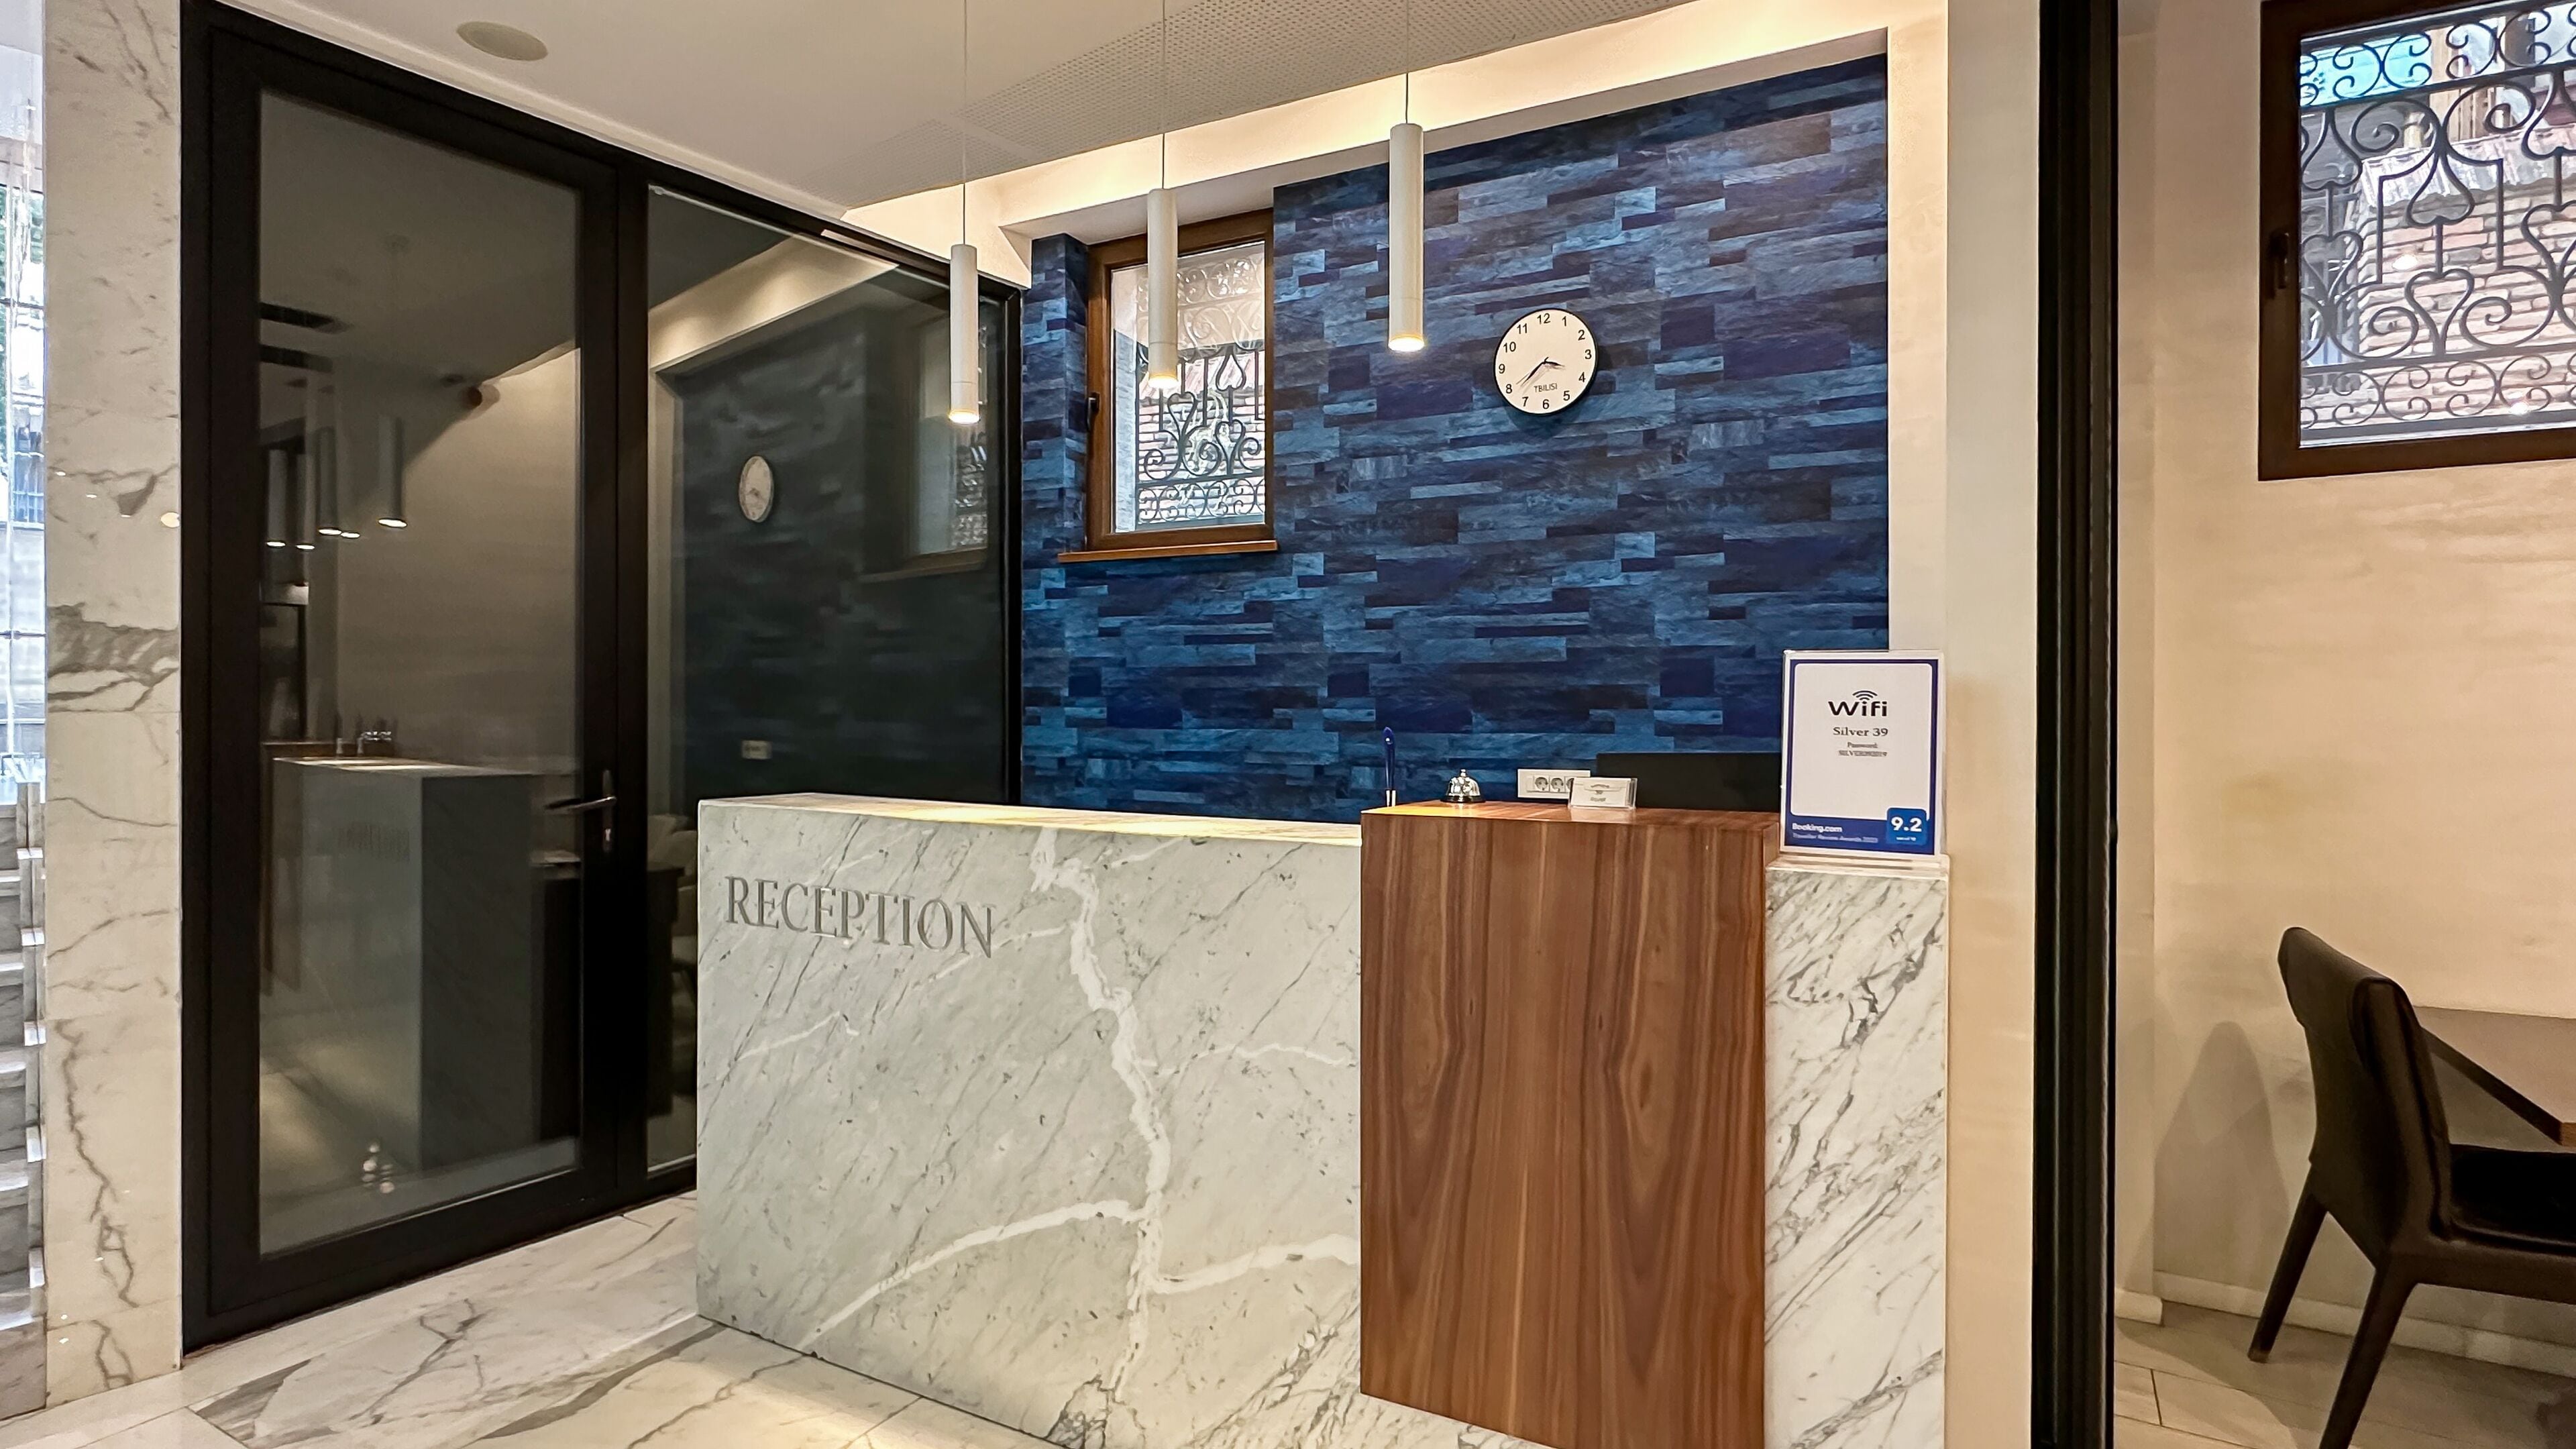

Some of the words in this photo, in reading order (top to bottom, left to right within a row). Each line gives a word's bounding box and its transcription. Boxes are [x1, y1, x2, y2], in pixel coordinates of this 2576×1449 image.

[1537, 313, 1551, 325] 12
[1562, 316, 1567, 327] 1
[1517, 323, 1528, 334] 11
[1578, 329, 1585, 341] 2
[1503, 341, 1516, 353] 10
[1585, 350, 1591, 360] 3
[1499, 364, 1505, 374] 9
[1578, 372, 1586, 382] 4
[1505, 384, 1513, 394] 8
[1534, 383, 1557, 392] TBILISI
[1563, 390, 1570, 401] 5
[1522, 396, 1529, 407] 7
[1542, 399, 1550, 409] 6
[1828, 701, 1888, 716] Wifi
[1833, 727, 1869, 737] Silver
[1872, 728, 1888, 737] 39
[1891, 816, 1922, 832] 9.2
[724, 876, 996, 958] RECEPTION
